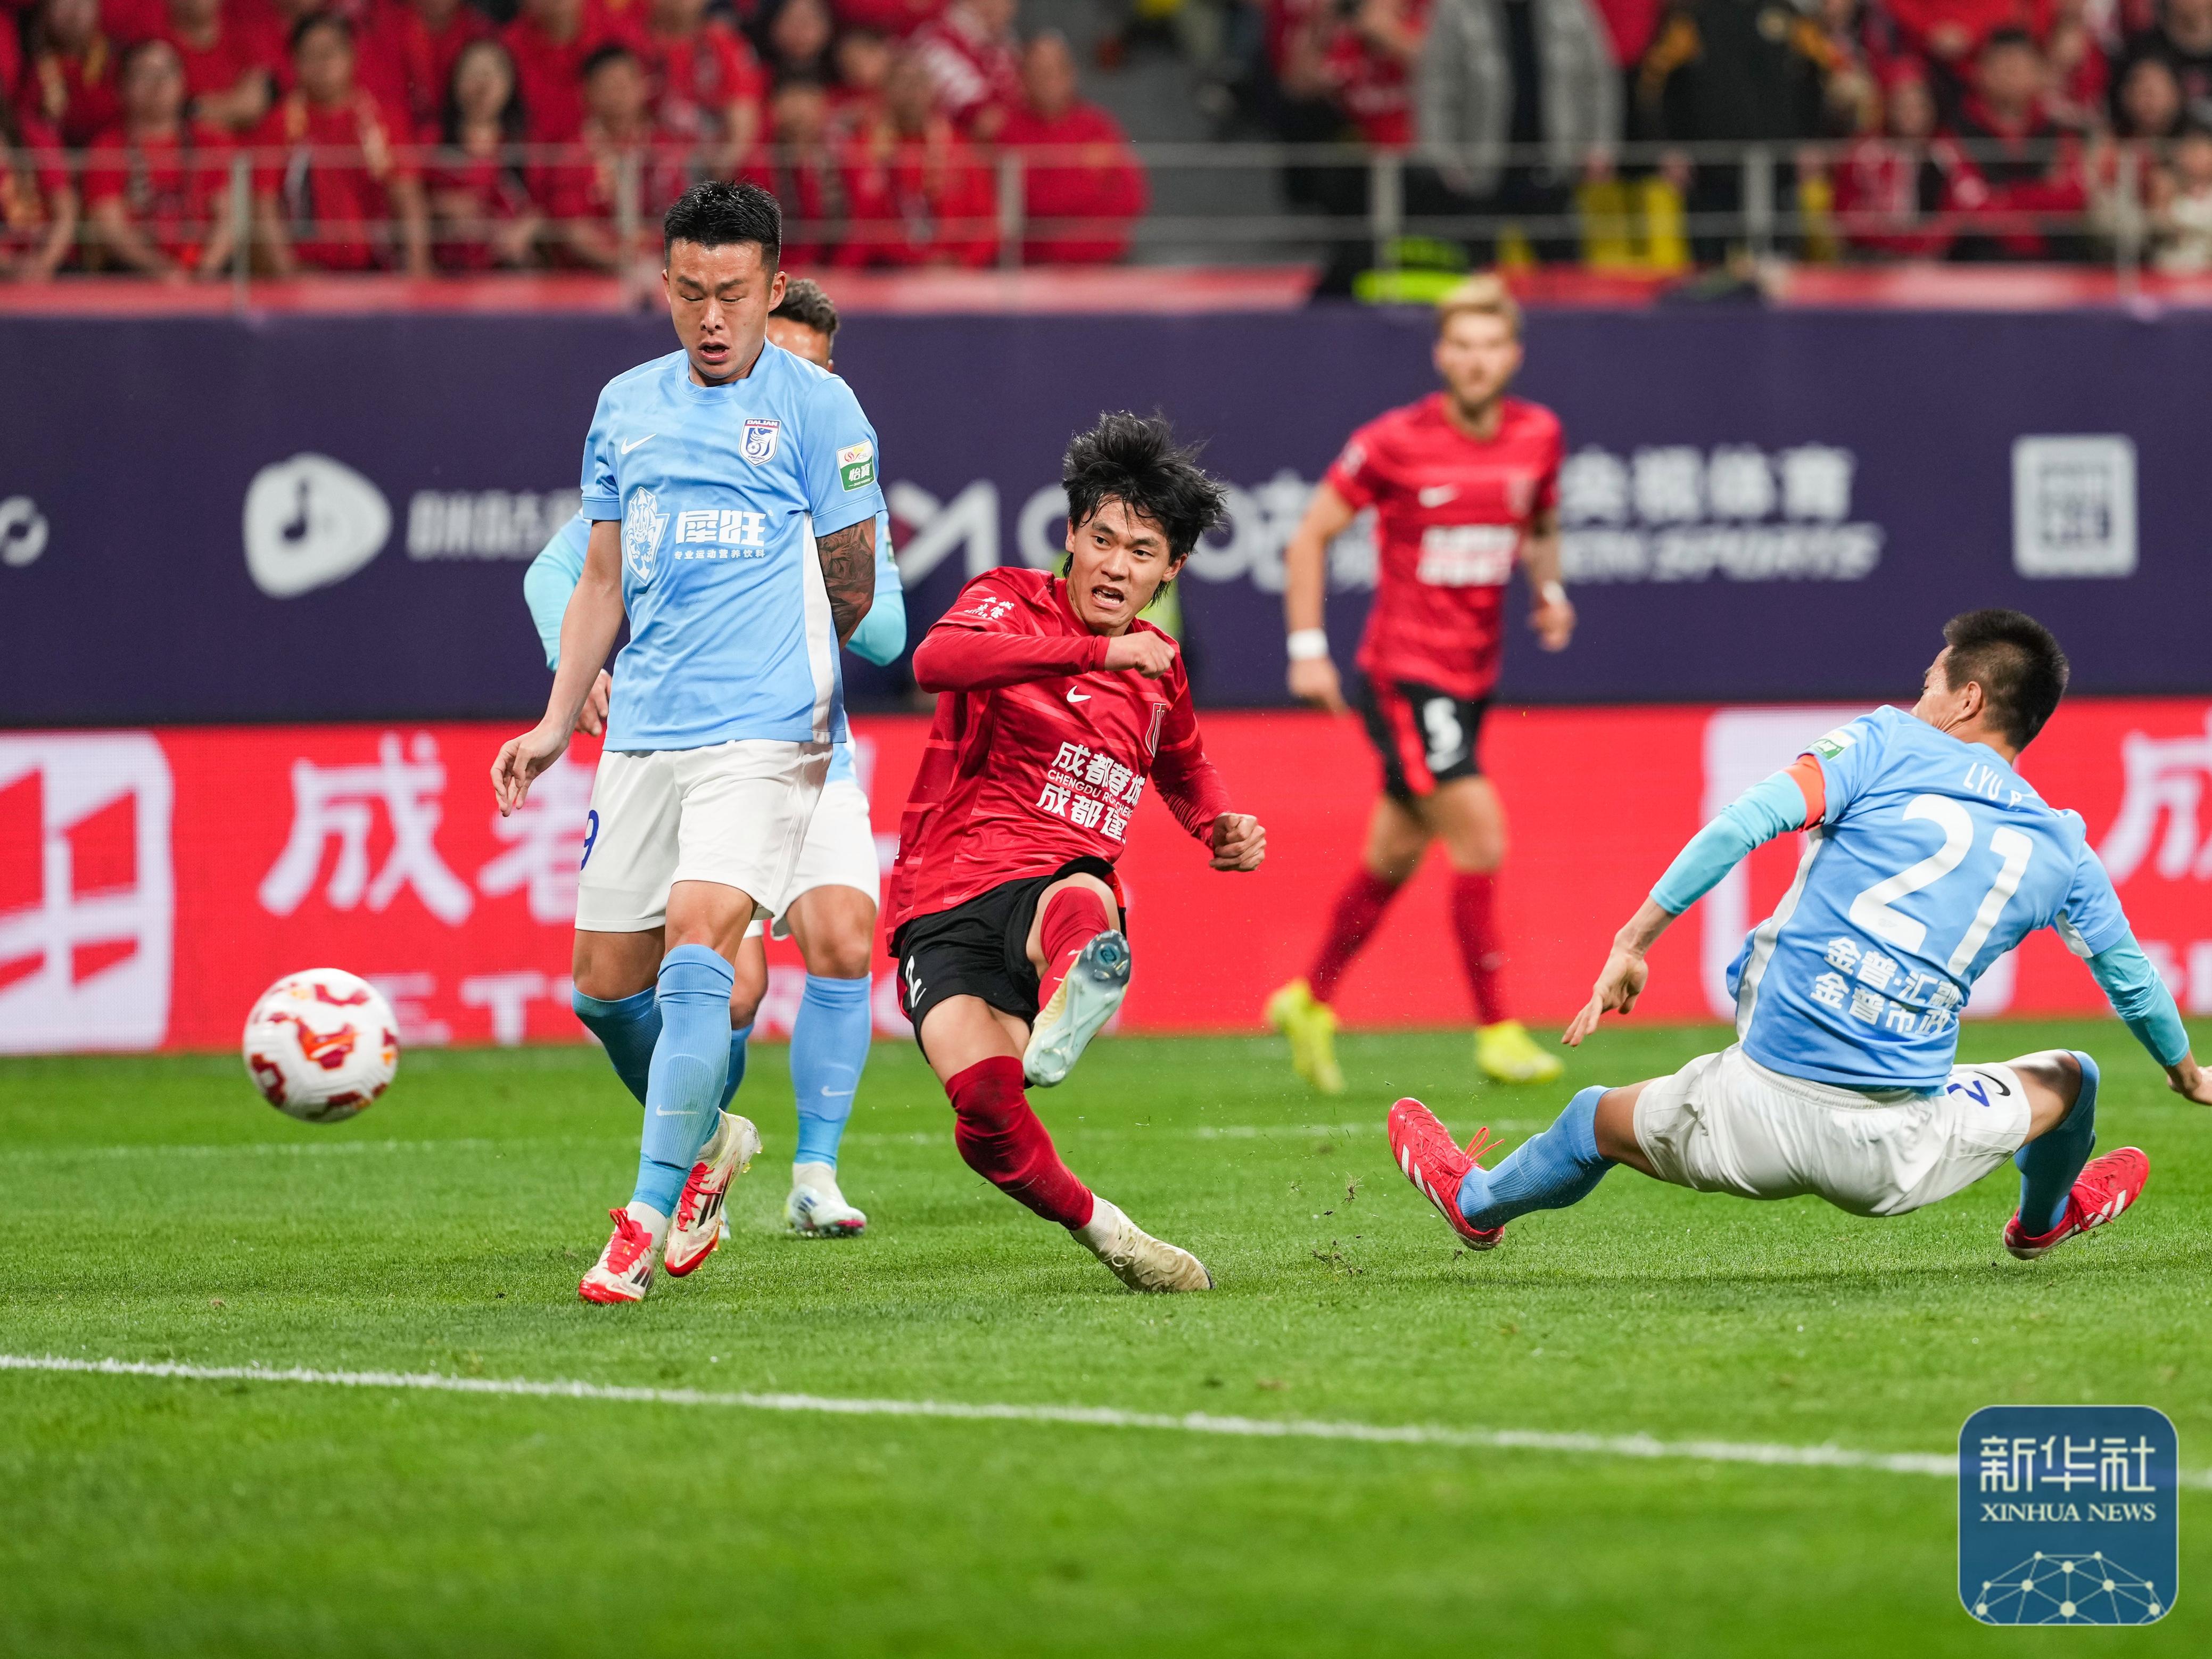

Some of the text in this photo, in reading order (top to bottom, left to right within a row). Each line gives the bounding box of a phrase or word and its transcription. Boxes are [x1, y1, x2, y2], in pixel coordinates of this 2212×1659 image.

[675, 509, 766, 547] 犀旺
[674, 549, 765, 560] 专业运动营养饮料
[1047, 769, 1102, 798] CHENGDU
[1963, 762, 2003, 801] LYU
[1036, 782, 1128, 845] 成都建
[1848, 793, 2033, 977] 21
[1810, 971, 1952, 1037] 金普市政
